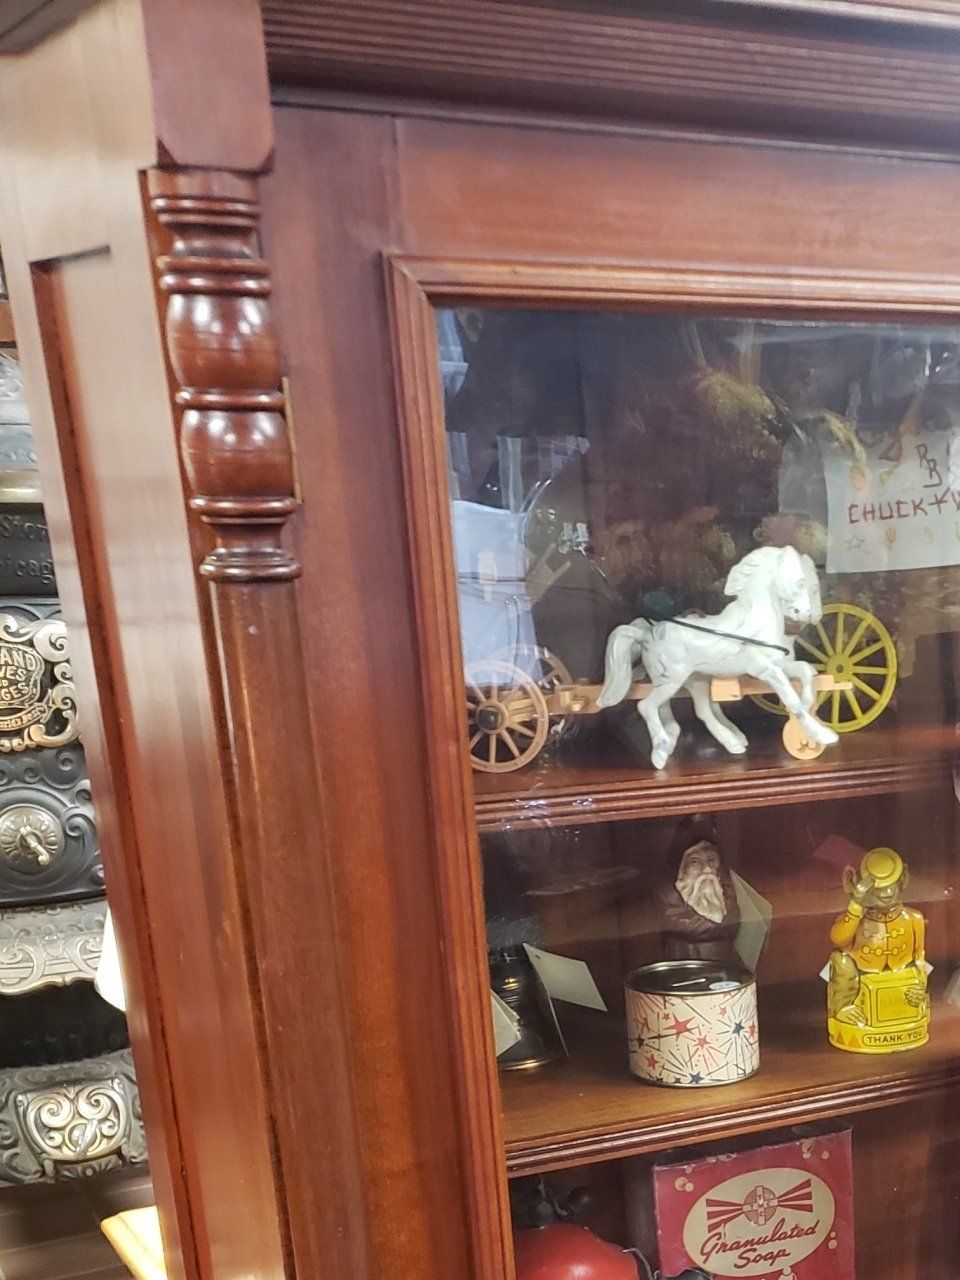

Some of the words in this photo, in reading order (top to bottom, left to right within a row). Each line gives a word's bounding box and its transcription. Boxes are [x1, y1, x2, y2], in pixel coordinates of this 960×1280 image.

[848, 499, 928, 524] CHUCK
[866, 1034, 903, 1044] THANK
[906, 1030, 923, 1040] YOU
[700, 1217, 820, 1264] Granulated
[733, 1247, 792, 1269] Soap
